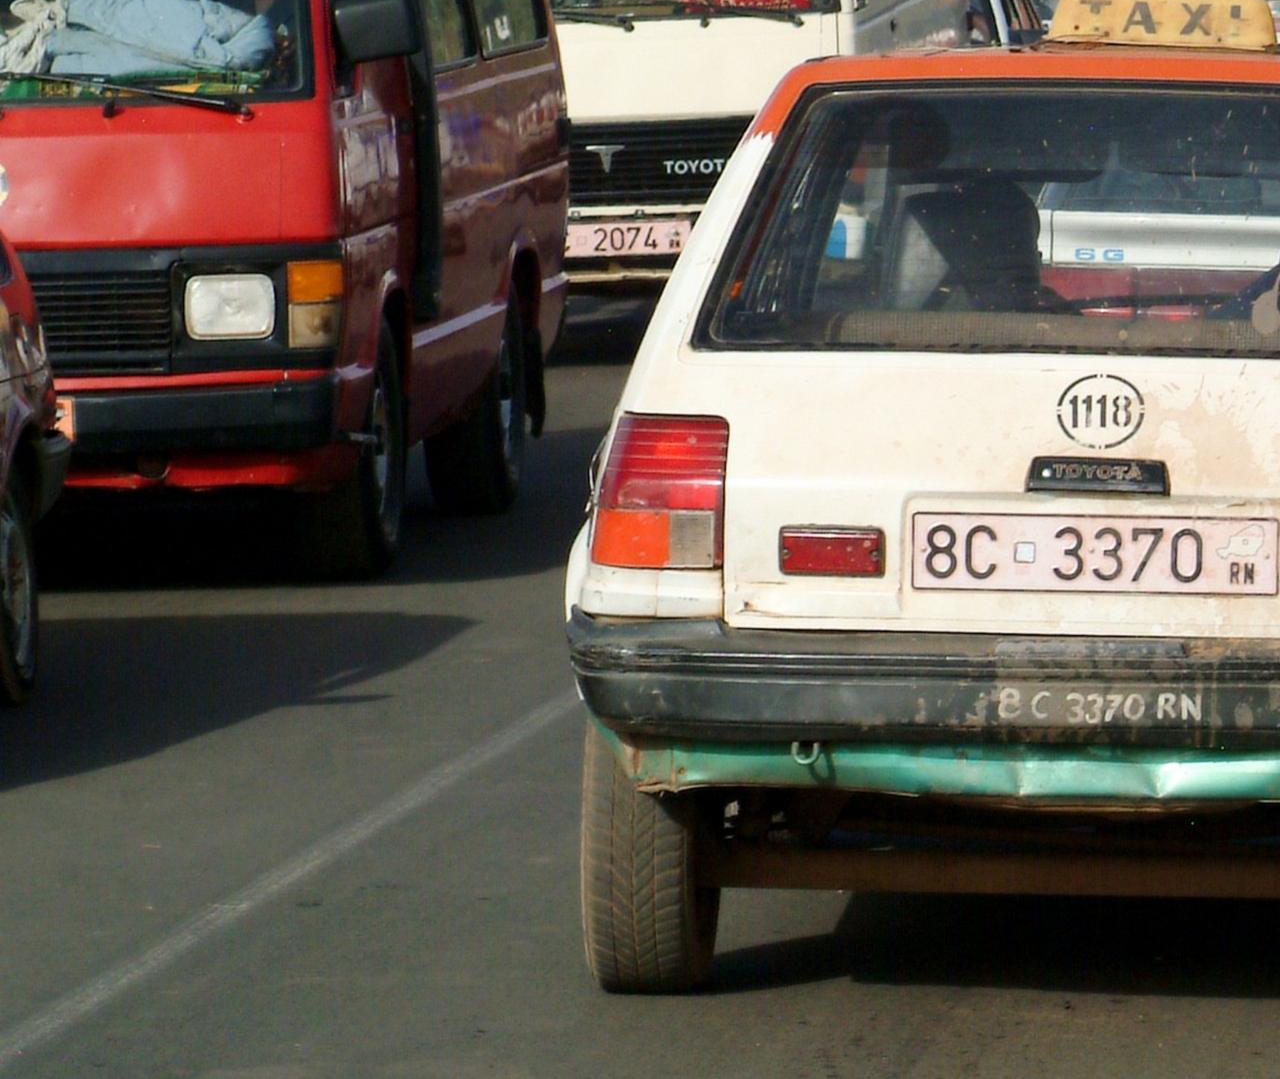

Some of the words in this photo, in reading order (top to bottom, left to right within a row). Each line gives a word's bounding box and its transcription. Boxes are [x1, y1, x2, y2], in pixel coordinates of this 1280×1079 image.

[663, 159, 728, 174] TOYOT
[593, 226, 658, 252] 2074
[1068, 394, 1132, 428] 1118
[1052, 462, 1143, 481] TOYOTA
[925, 524, 998, 579] 8C
[1052, 527, 1203, 584] 3370
[1230, 561, 1255, 586] RN
[1065, 693, 1145, 724] 3370
[1156, 691, 1203, 722] RN
